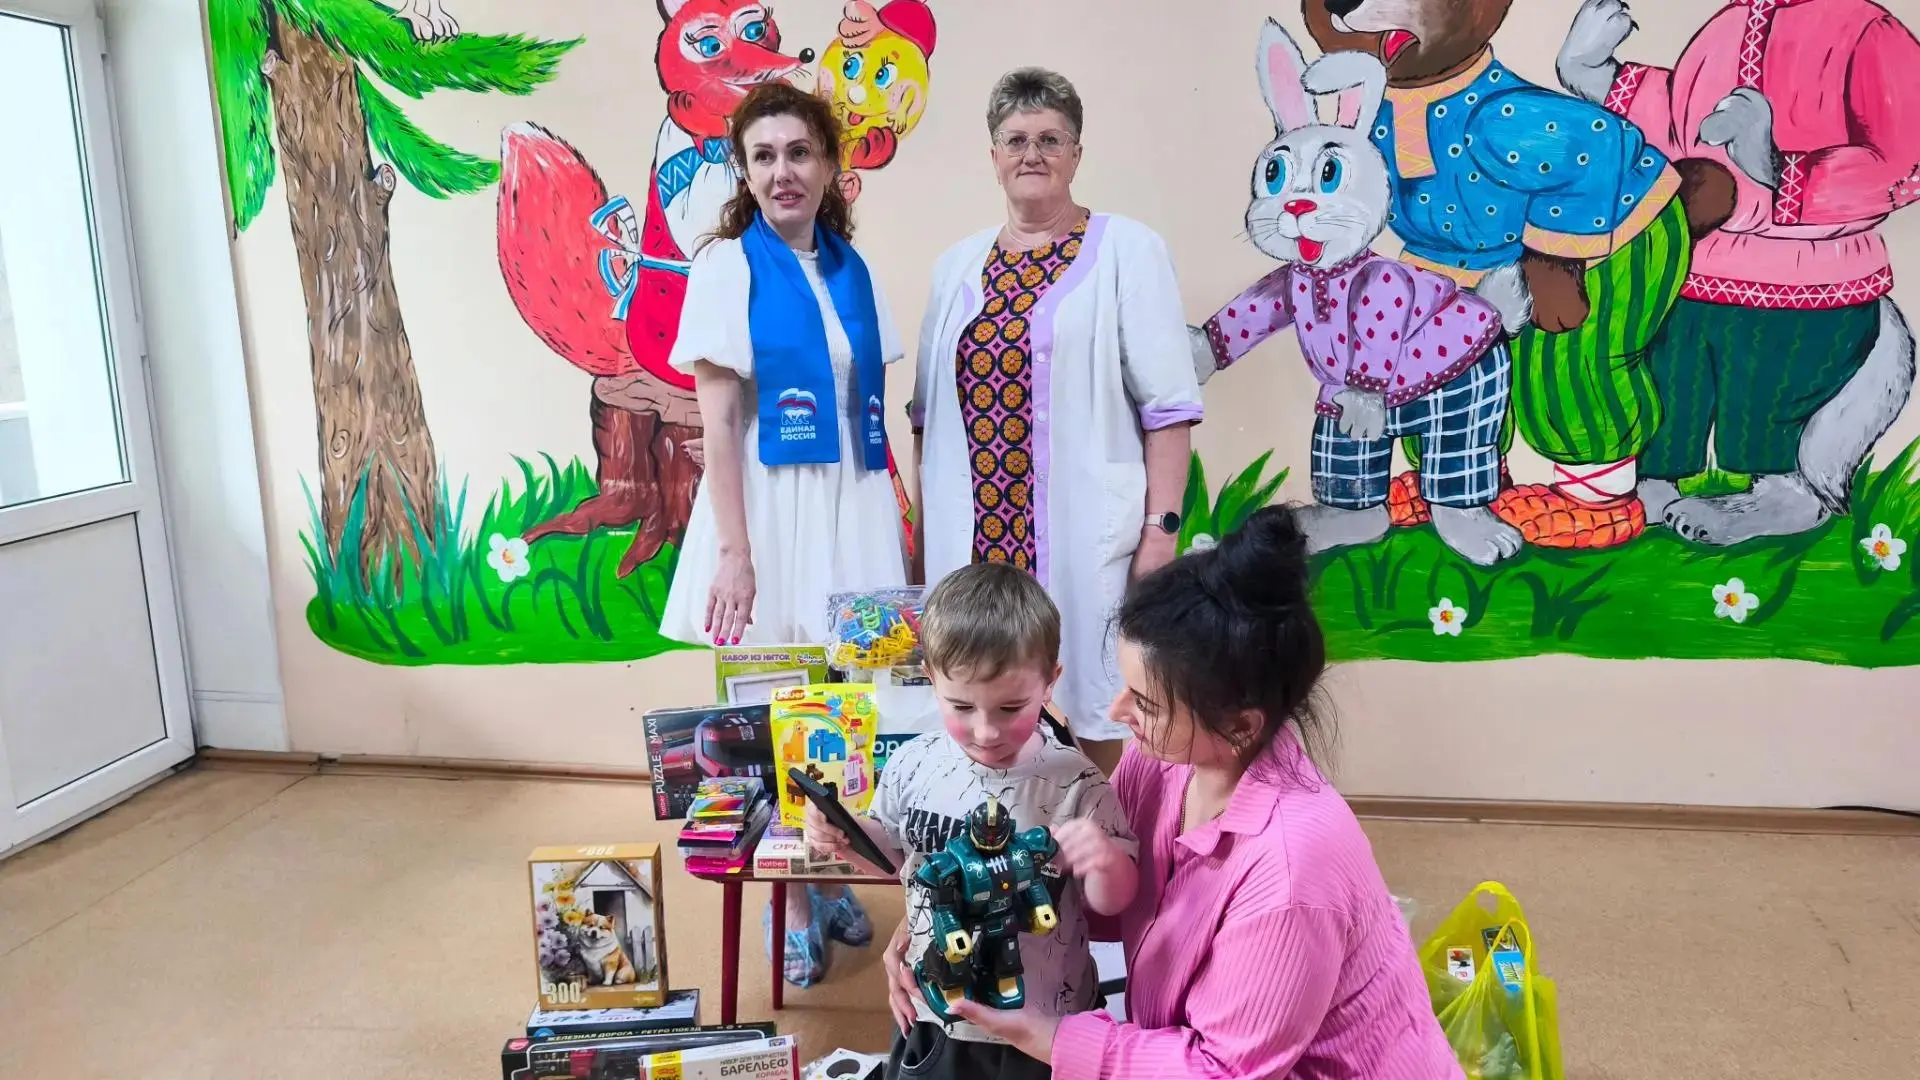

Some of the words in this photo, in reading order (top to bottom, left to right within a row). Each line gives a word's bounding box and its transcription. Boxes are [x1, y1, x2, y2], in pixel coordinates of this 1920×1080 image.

[780, 425, 816, 434] ЕДИНАЯ
[781, 433, 817, 441] РОССИЯ
[721, 654, 748, 662] НАБОР
[647, 718, 659, 744] MAXI
[652, 755, 665, 794] PUZZLE
[547, 1033, 597, 1041] ЖЕЛЕЗНАЯ
[598, 1030, 633, 1038] ДОРОГА
[720, 1058, 789, 1077] БАРЕЛЬЕФ
